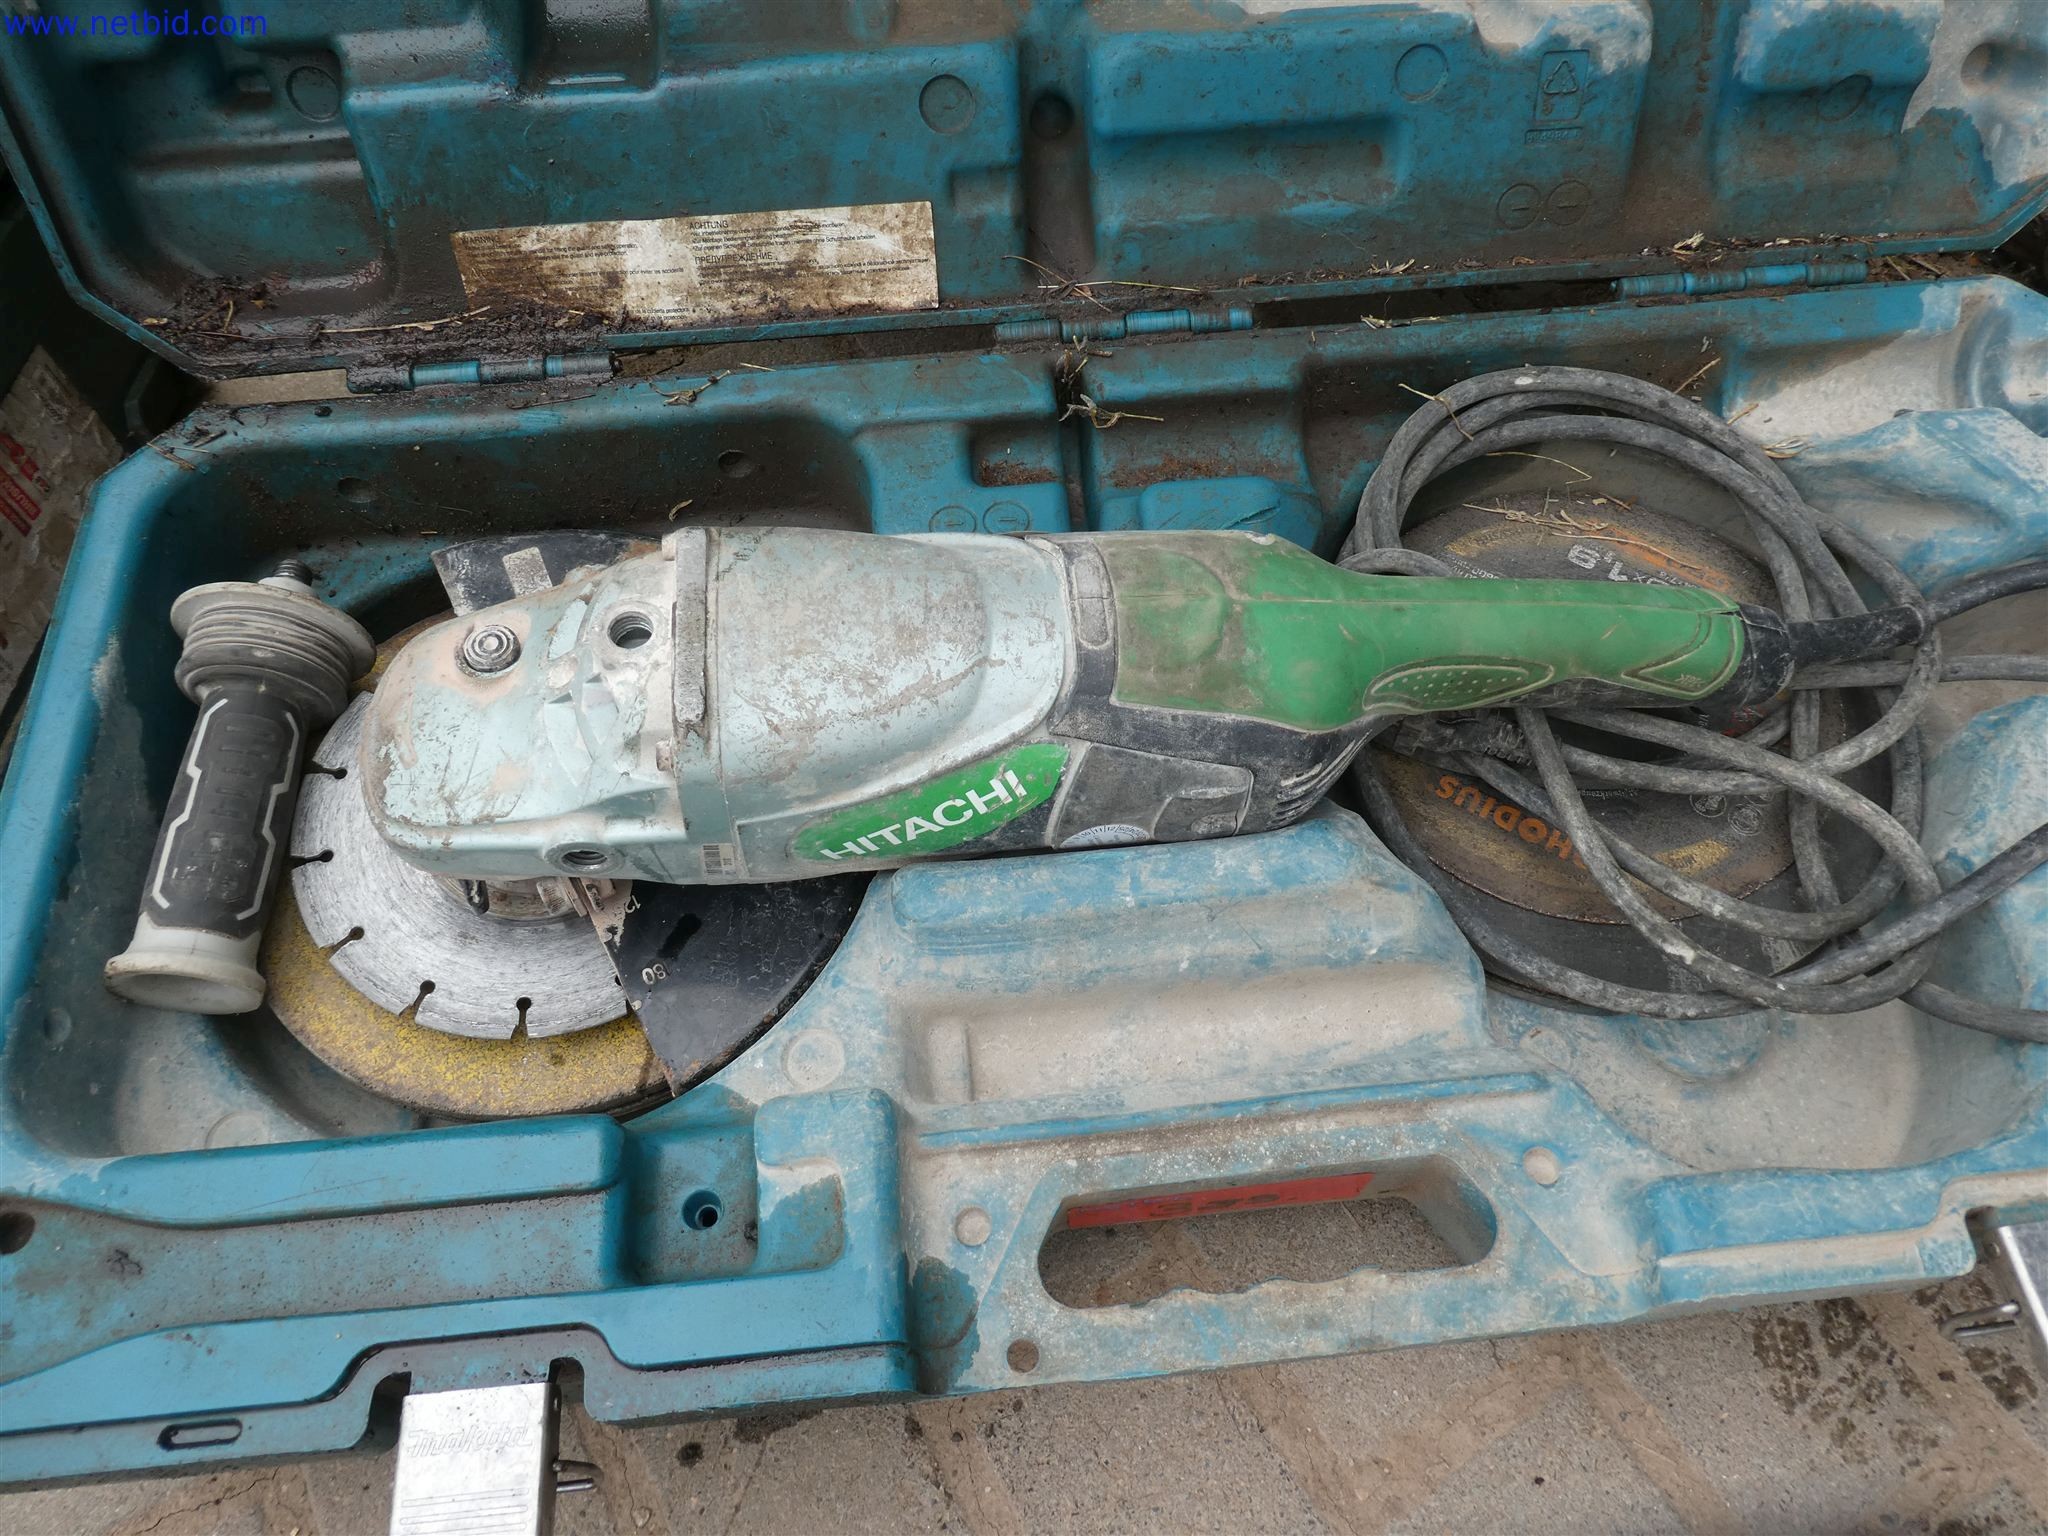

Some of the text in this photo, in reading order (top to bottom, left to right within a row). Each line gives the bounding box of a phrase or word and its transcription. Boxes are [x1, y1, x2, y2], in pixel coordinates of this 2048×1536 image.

[689, 220, 729, 230] ACHTUNG
[694, 251, 773, 264] ПРЕДУПРЕЖДЕНИЕ
[820, 769, 1028, 861] HITACHI
[1435, 774, 1587, 870] HODIUS
